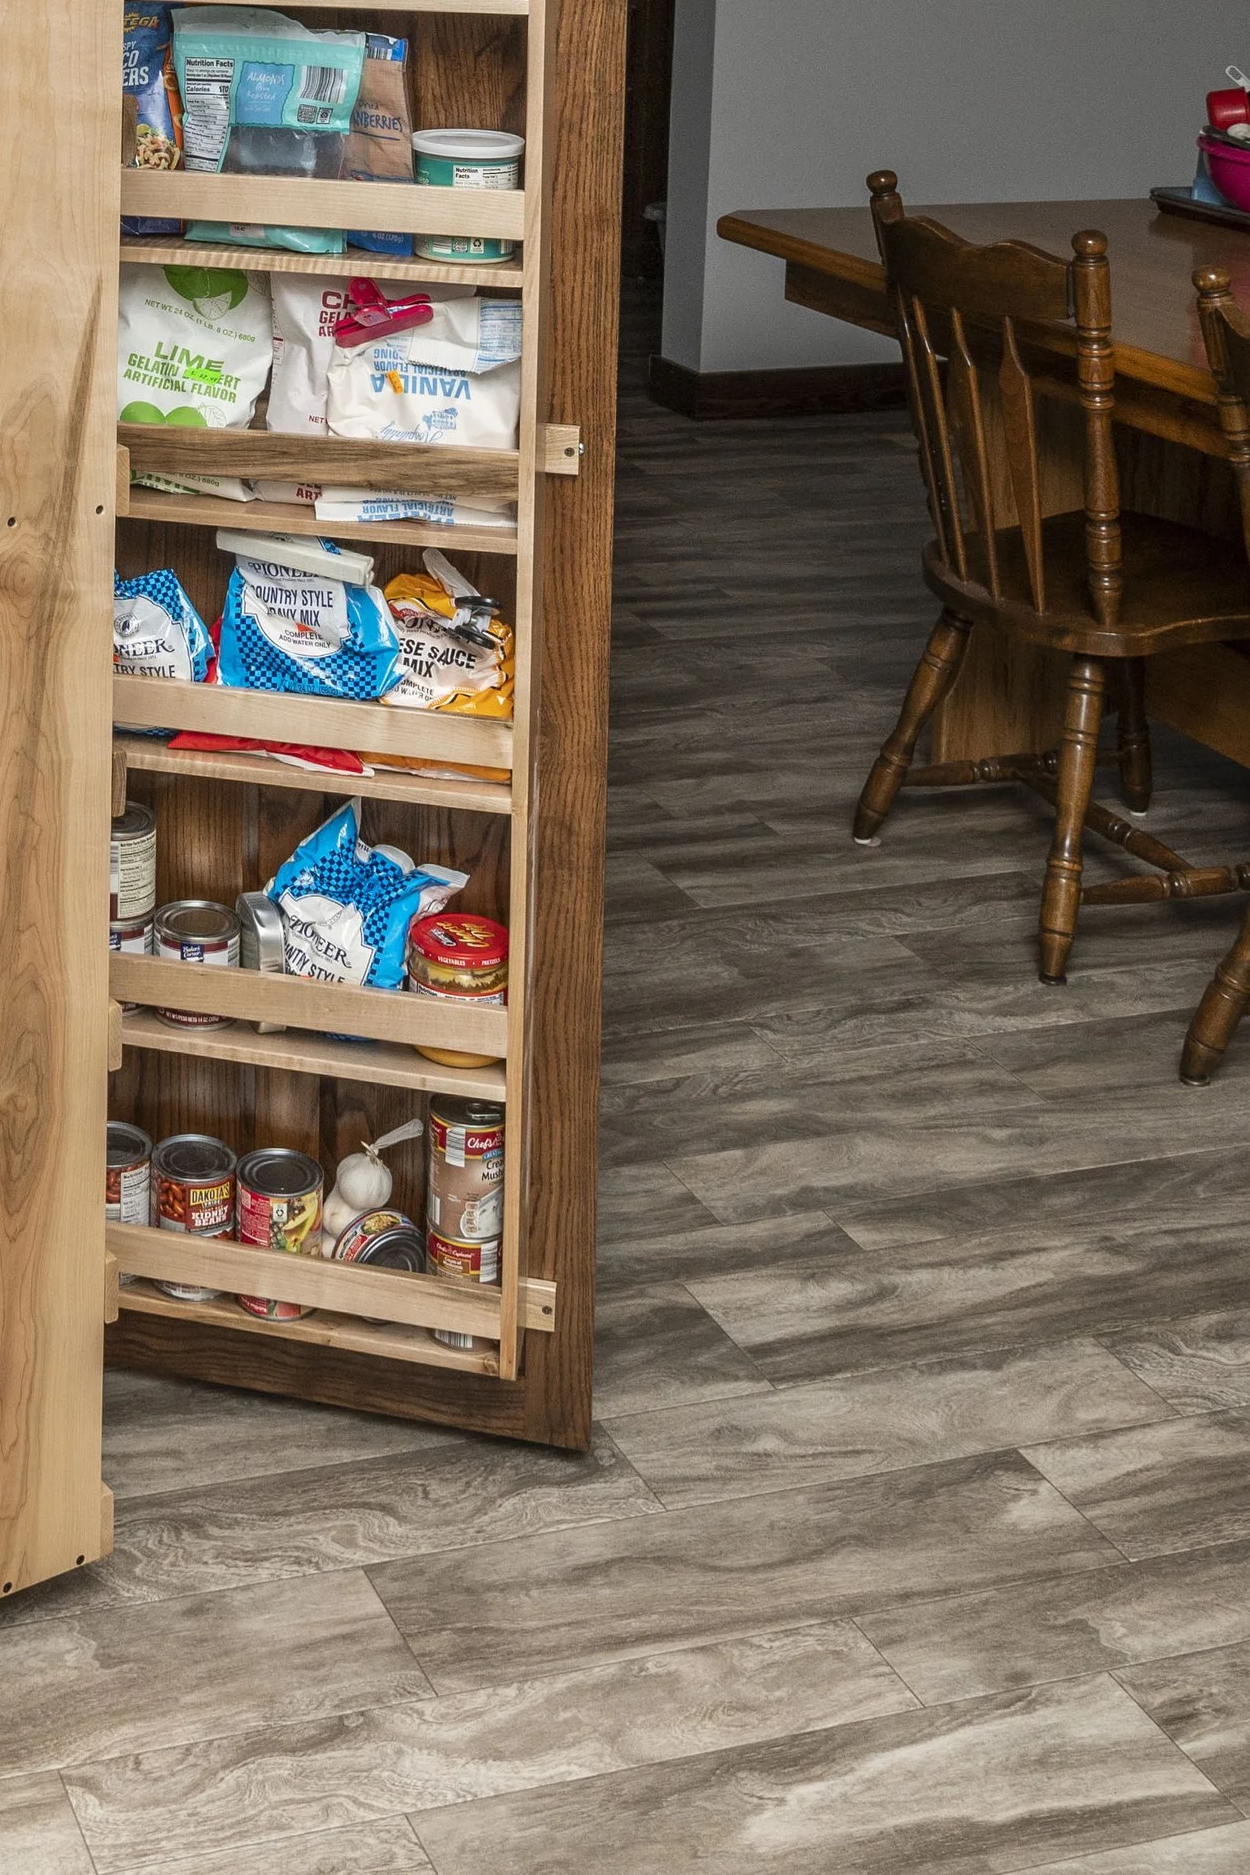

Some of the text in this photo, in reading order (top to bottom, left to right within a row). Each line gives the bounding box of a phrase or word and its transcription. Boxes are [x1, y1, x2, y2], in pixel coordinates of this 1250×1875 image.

[186, 59, 233, 68] Nutrition Facts
[247, 71, 286, 85] ALMONDS
[358, 99, 379, 110] Dried
[145, 299, 256, 343] NET WT. 24 OZ. (1 LB. 8 OZ.) 680g
[154, 341, 225, 373] LIME
[374, 349, 400, 359] DING
[128, 353, 180, 377] GELATIN
[374, 360, 409, 373] FLAVOR
[124, 368, 187, 393] ARTIFICIAL
[191, 383, 237, 403] FLAVOR
[370, 374, 472, 401] VANILA
[308, 415, 325, 425] NET
[202, 477, 220, 487] 680g
[362, 504, 399, 515] FLAVOR
[251, 584, 334, 608] OUNTRY STYLE
[300, 609, 321, 627] MIX
[284, 629, 324, 640] COMPLETE
[115, 638, 175, 657] NEER
[292, 638, 314, 647] WATER
[428, 646, 477, 669] SAUCE
[139, 665, 177, 679] STYLE
[403, 657, 435, 678] MIX
[289, 915, 352, 969] PIONEER
[437, 956, 501, 966] VEGETABLES PRETZELS
[308, 964, 346, 984] STYLE
[467, 1137, 493, 1149] Chef's
[191, 1182, 230, 1204] DAKOTA'S
[191, 1206, 228, 1220] KIDNEY
[194, 1213, 227, 1227] BEANS
